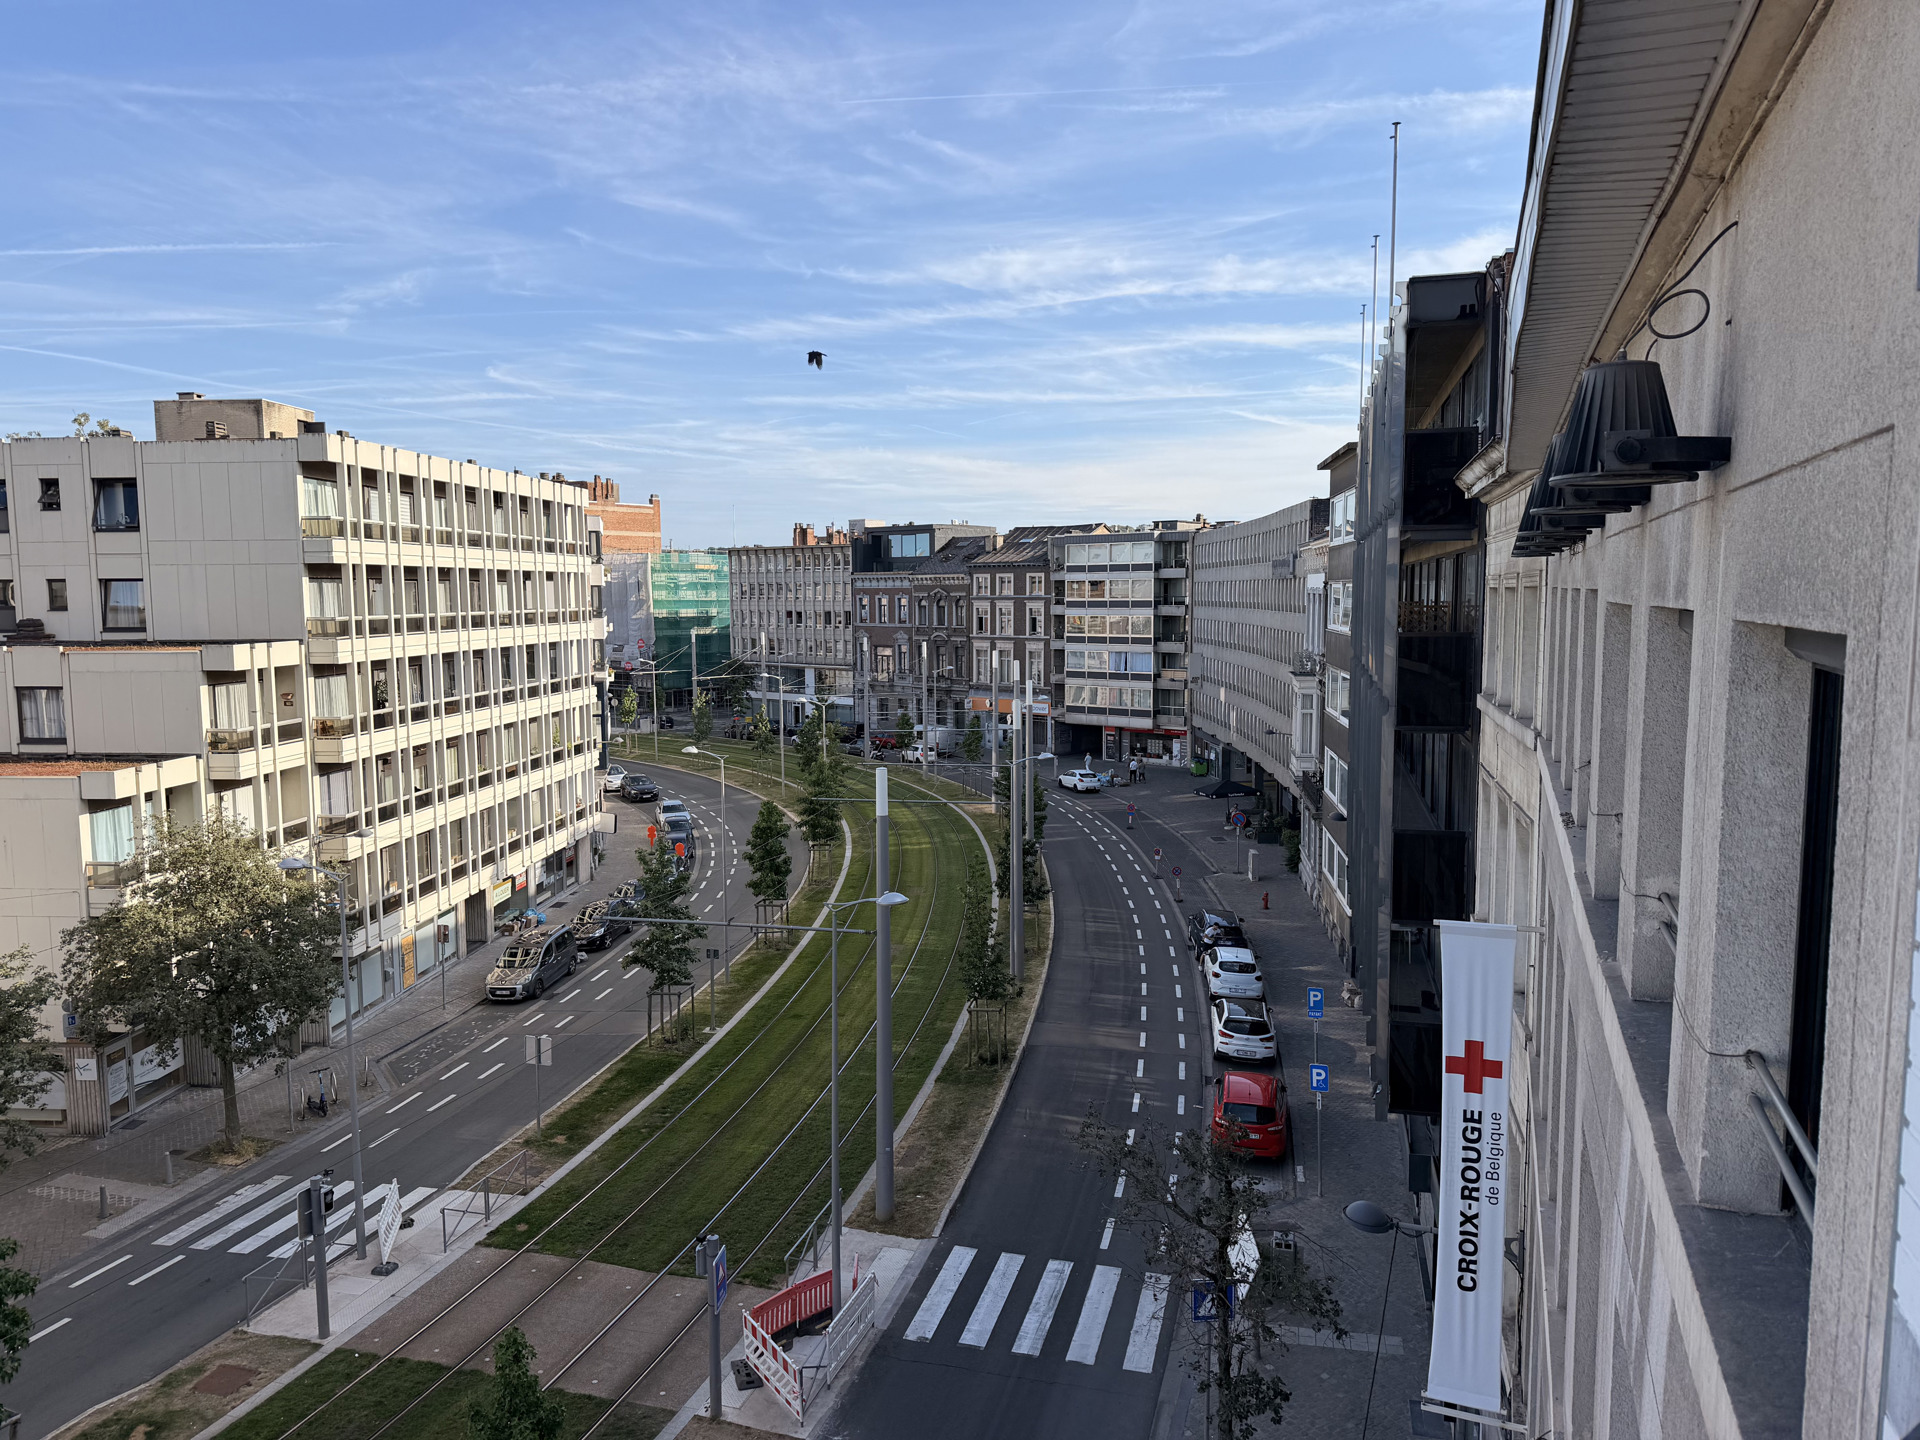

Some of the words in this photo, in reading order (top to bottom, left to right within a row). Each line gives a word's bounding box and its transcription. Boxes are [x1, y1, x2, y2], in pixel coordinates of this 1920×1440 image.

[1310, 991, 1322, 1006] P
[1312, 1068, 1326, 1087] P
[1485, 1112, 1504, 1182] Belgique
[1457, 1109, 1482, 1292] CROIX-ROUGE
[1485, 1186, 1500, 1205] de
